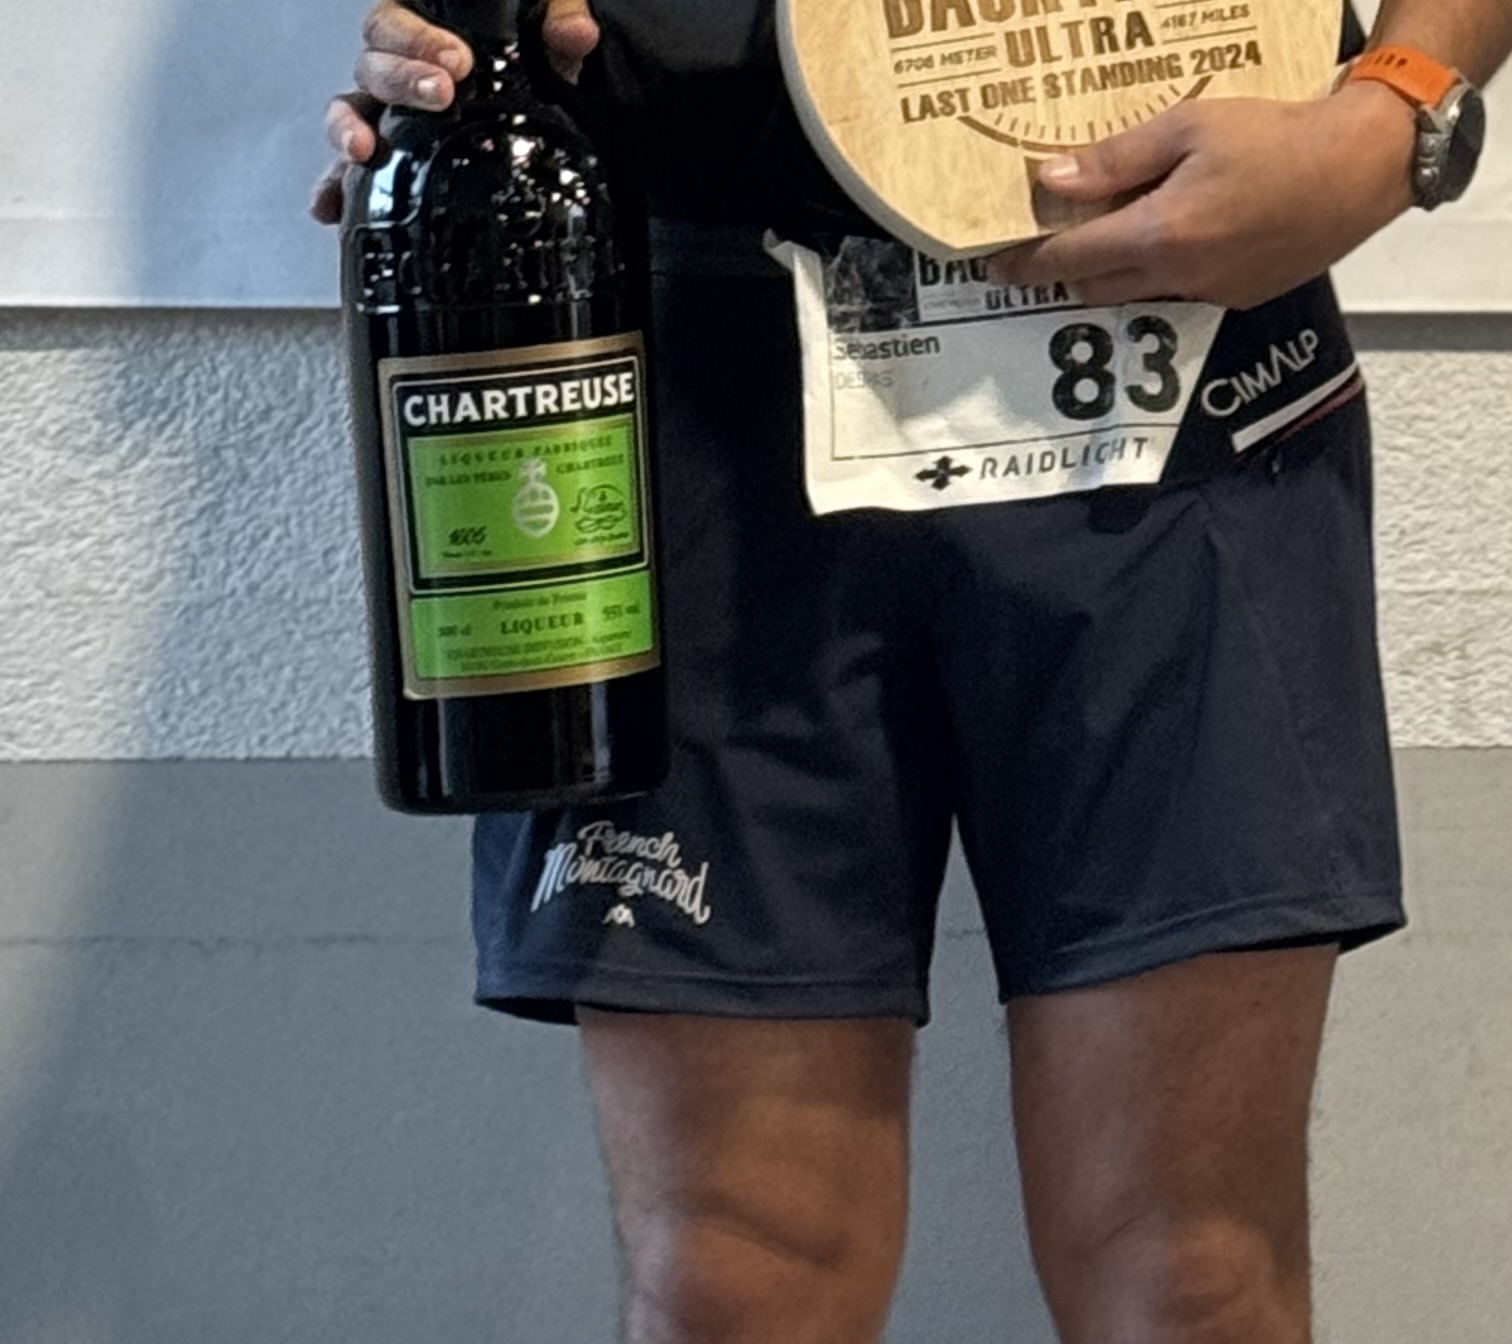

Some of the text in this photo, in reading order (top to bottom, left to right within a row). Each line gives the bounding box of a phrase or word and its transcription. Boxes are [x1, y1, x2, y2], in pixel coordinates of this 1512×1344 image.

[939, 43, 998, 68] METER
[1003, 10, 1155, 69] ULTRA
[900, 39, 1263, 125] LAST ONE STANDING 2024
[1048, 314, 1181, 421] 83
[1201, 328, 1320, 418] CIMALP
[403, 371, 635, 427] CHARTREUSE
[980, 436, 1149, 480] RAIDLIGHT
[500, 611, 584, 635] LIQUEUR
[577, 820, 682, 868] French
[530, 842, 711, 925] Montagnard
